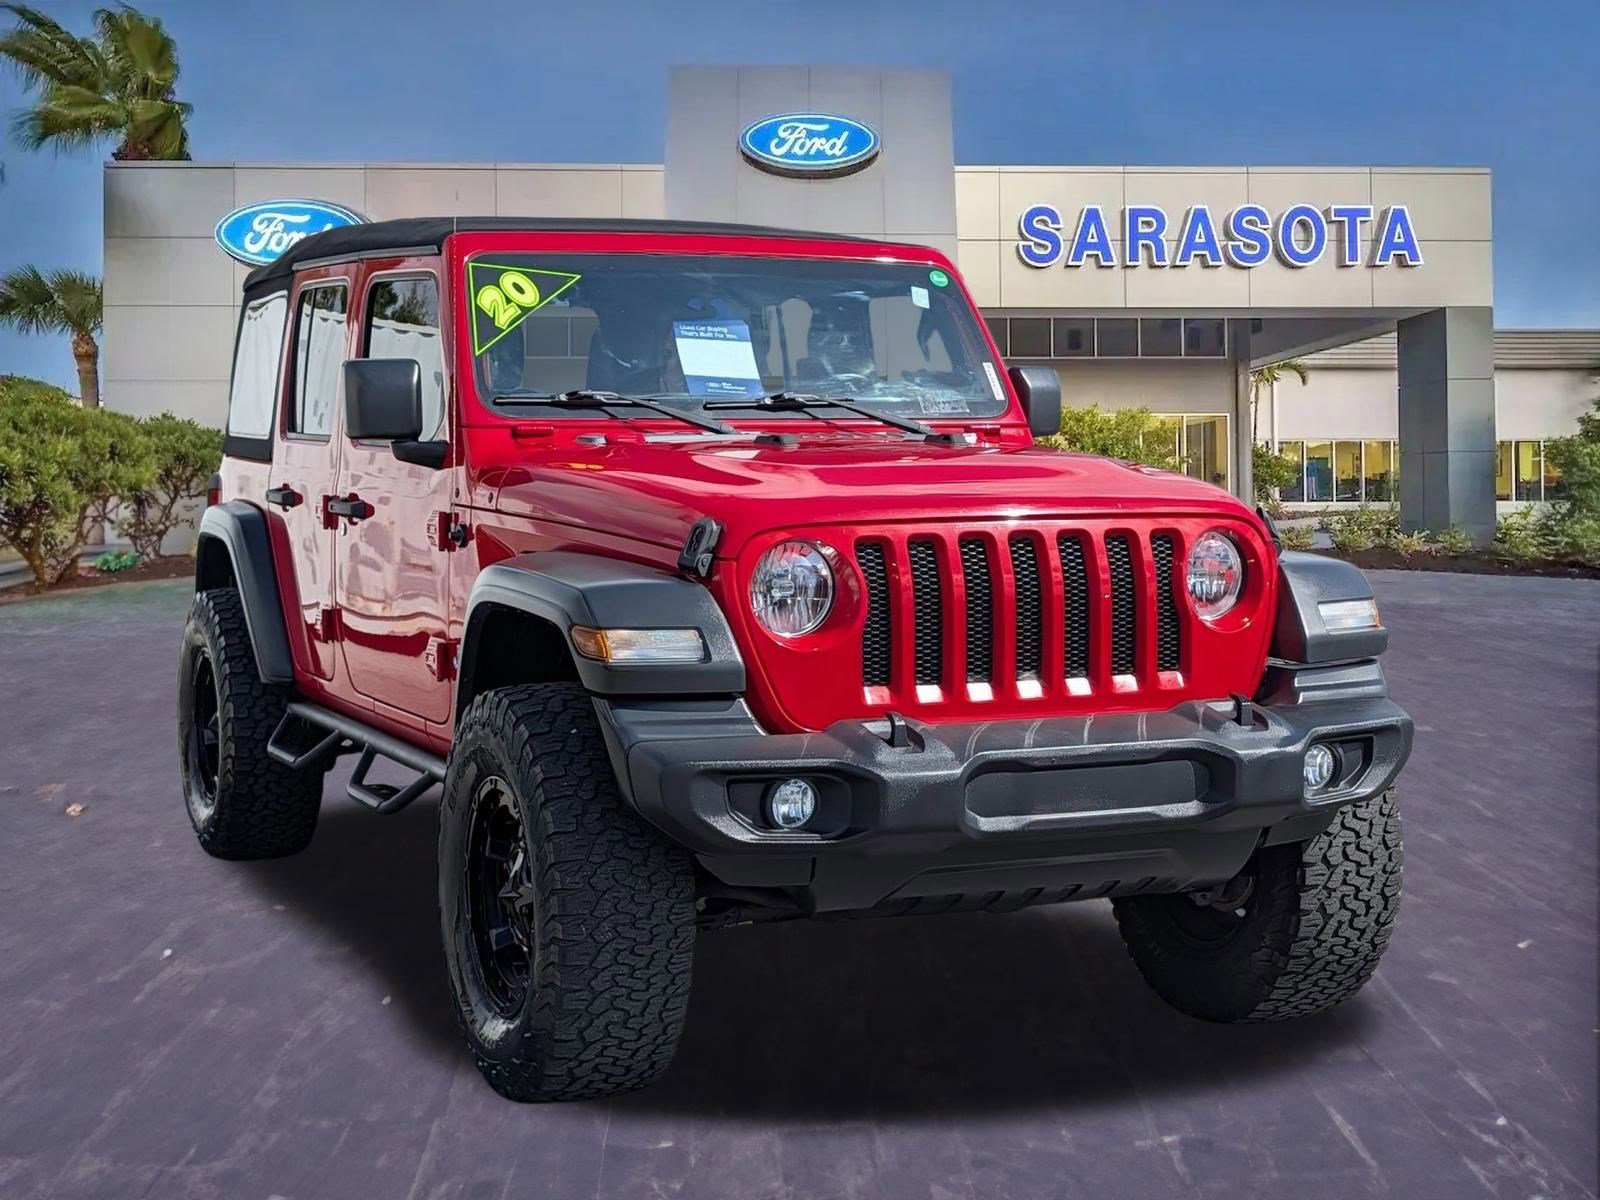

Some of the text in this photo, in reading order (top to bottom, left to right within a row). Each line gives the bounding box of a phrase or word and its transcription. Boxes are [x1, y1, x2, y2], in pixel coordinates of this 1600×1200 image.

[770, 122, 849, 156] Ford
[244, 212, 333, 253] For
[1017, 204, 1425, 268] SARASOTA
[477, 271, 540, 330] 20
